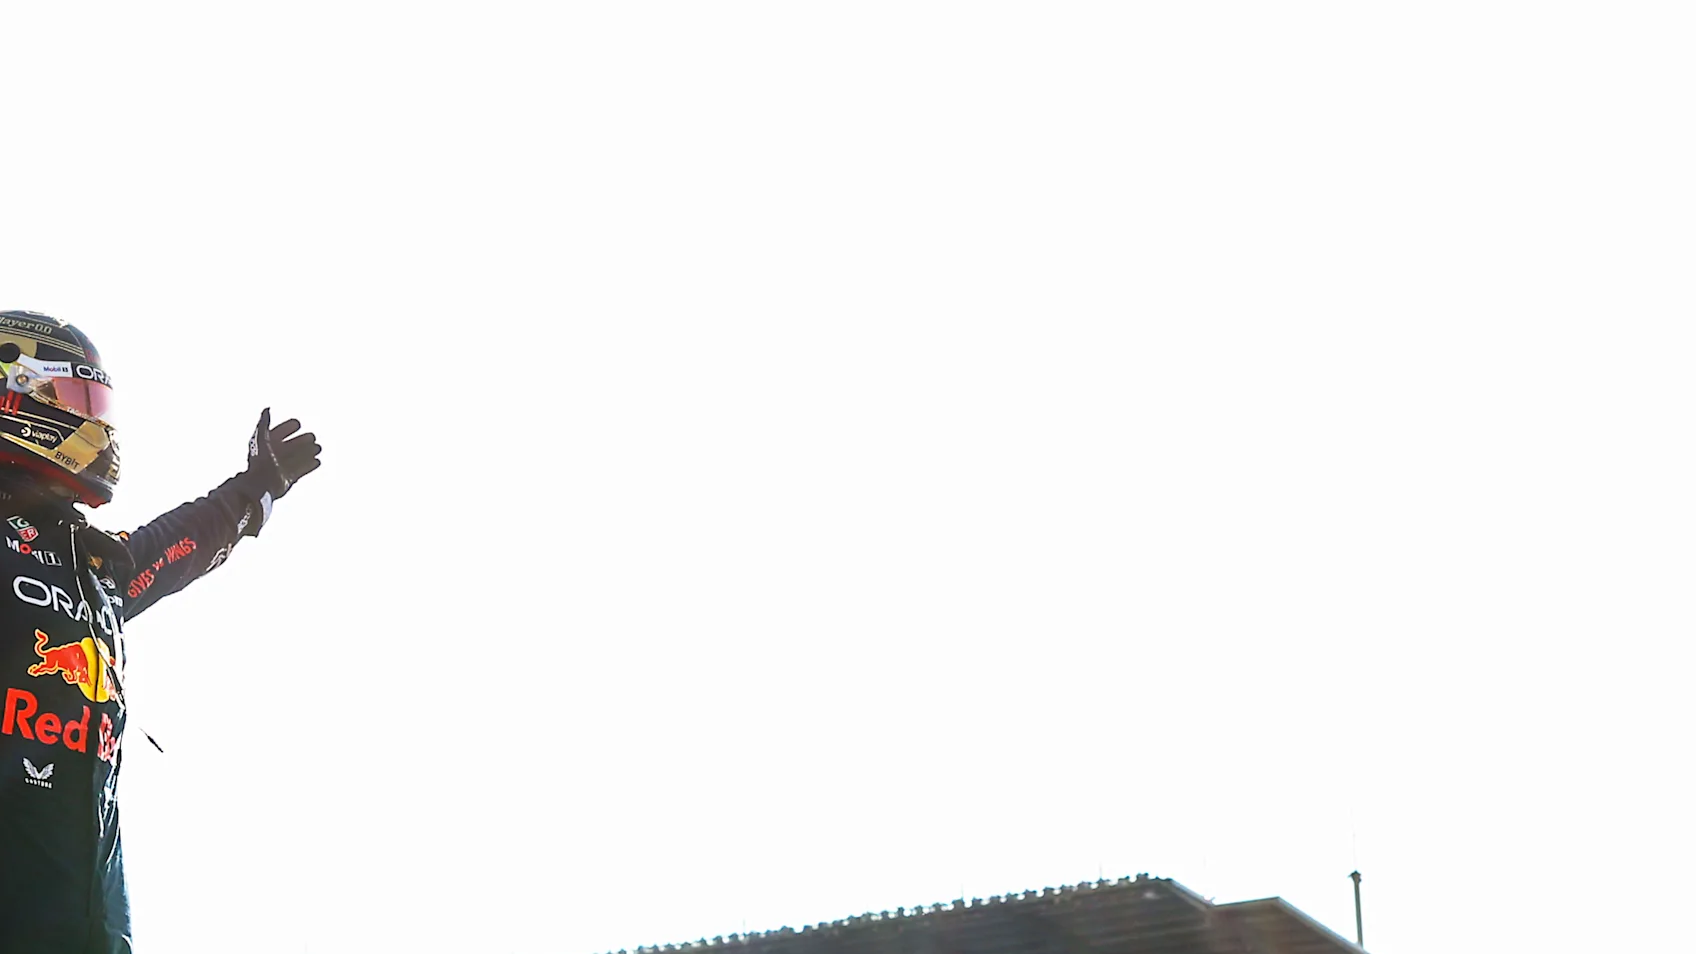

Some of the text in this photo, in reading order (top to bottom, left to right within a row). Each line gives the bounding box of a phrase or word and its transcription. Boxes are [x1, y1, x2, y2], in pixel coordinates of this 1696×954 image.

[55, 451, 80, 470] BYBIT
[127, 569, 155, 598] GIVES
[164, 537, 197, 564] WINGS
[1, 688, 91, 753] Red
